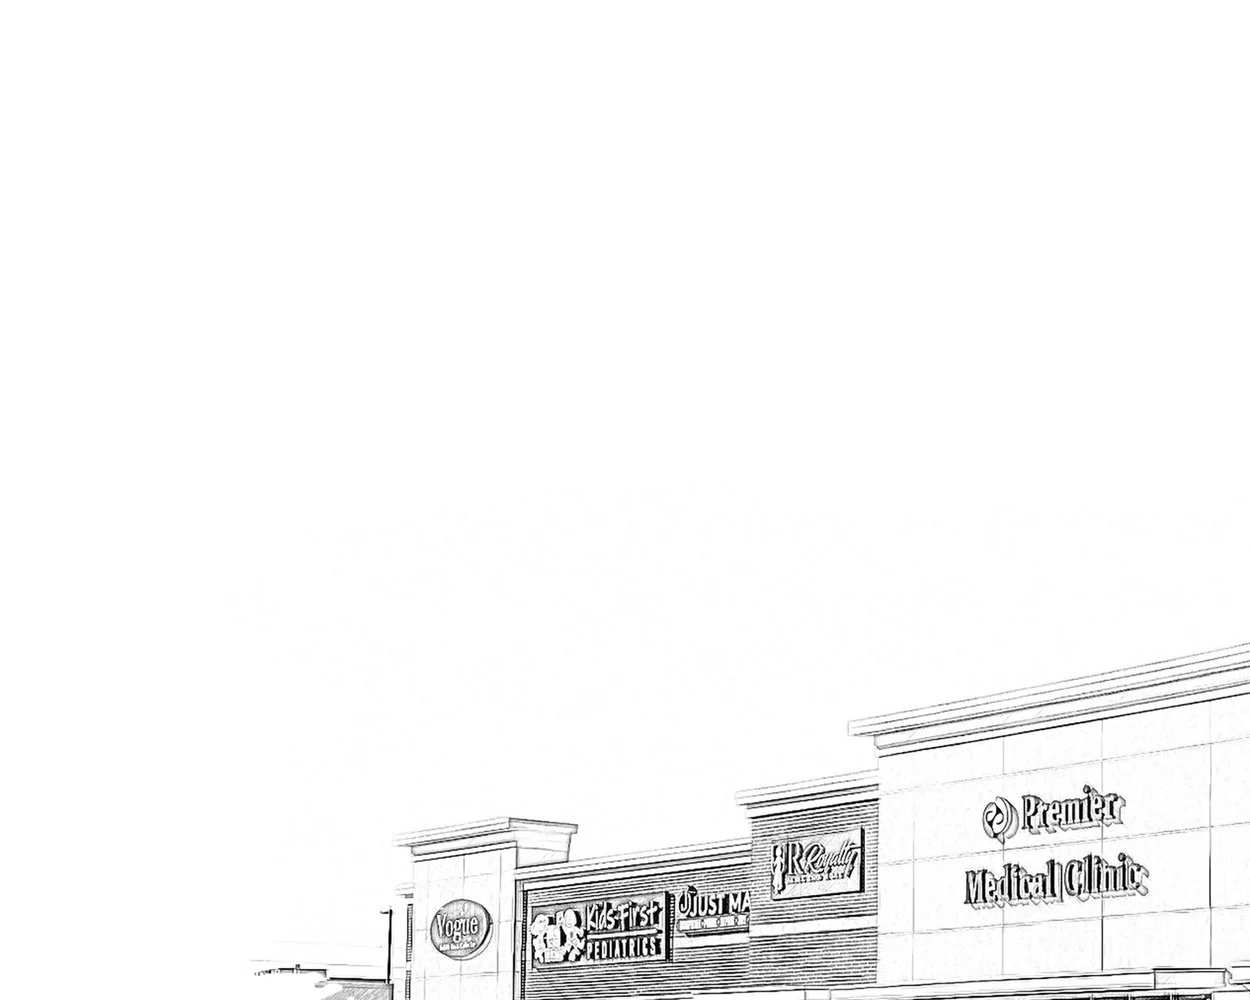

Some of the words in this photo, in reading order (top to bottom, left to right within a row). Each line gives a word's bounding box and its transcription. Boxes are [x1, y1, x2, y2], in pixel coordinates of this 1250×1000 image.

[1021, 785, 1125, 833] Premier
[964, 859, 1063, 908] Medical
[690, 892, 726, 917] JUST
[436, 912, 480, 943] Vogue
[586, 935, 657, 960] PEDIATRICS
